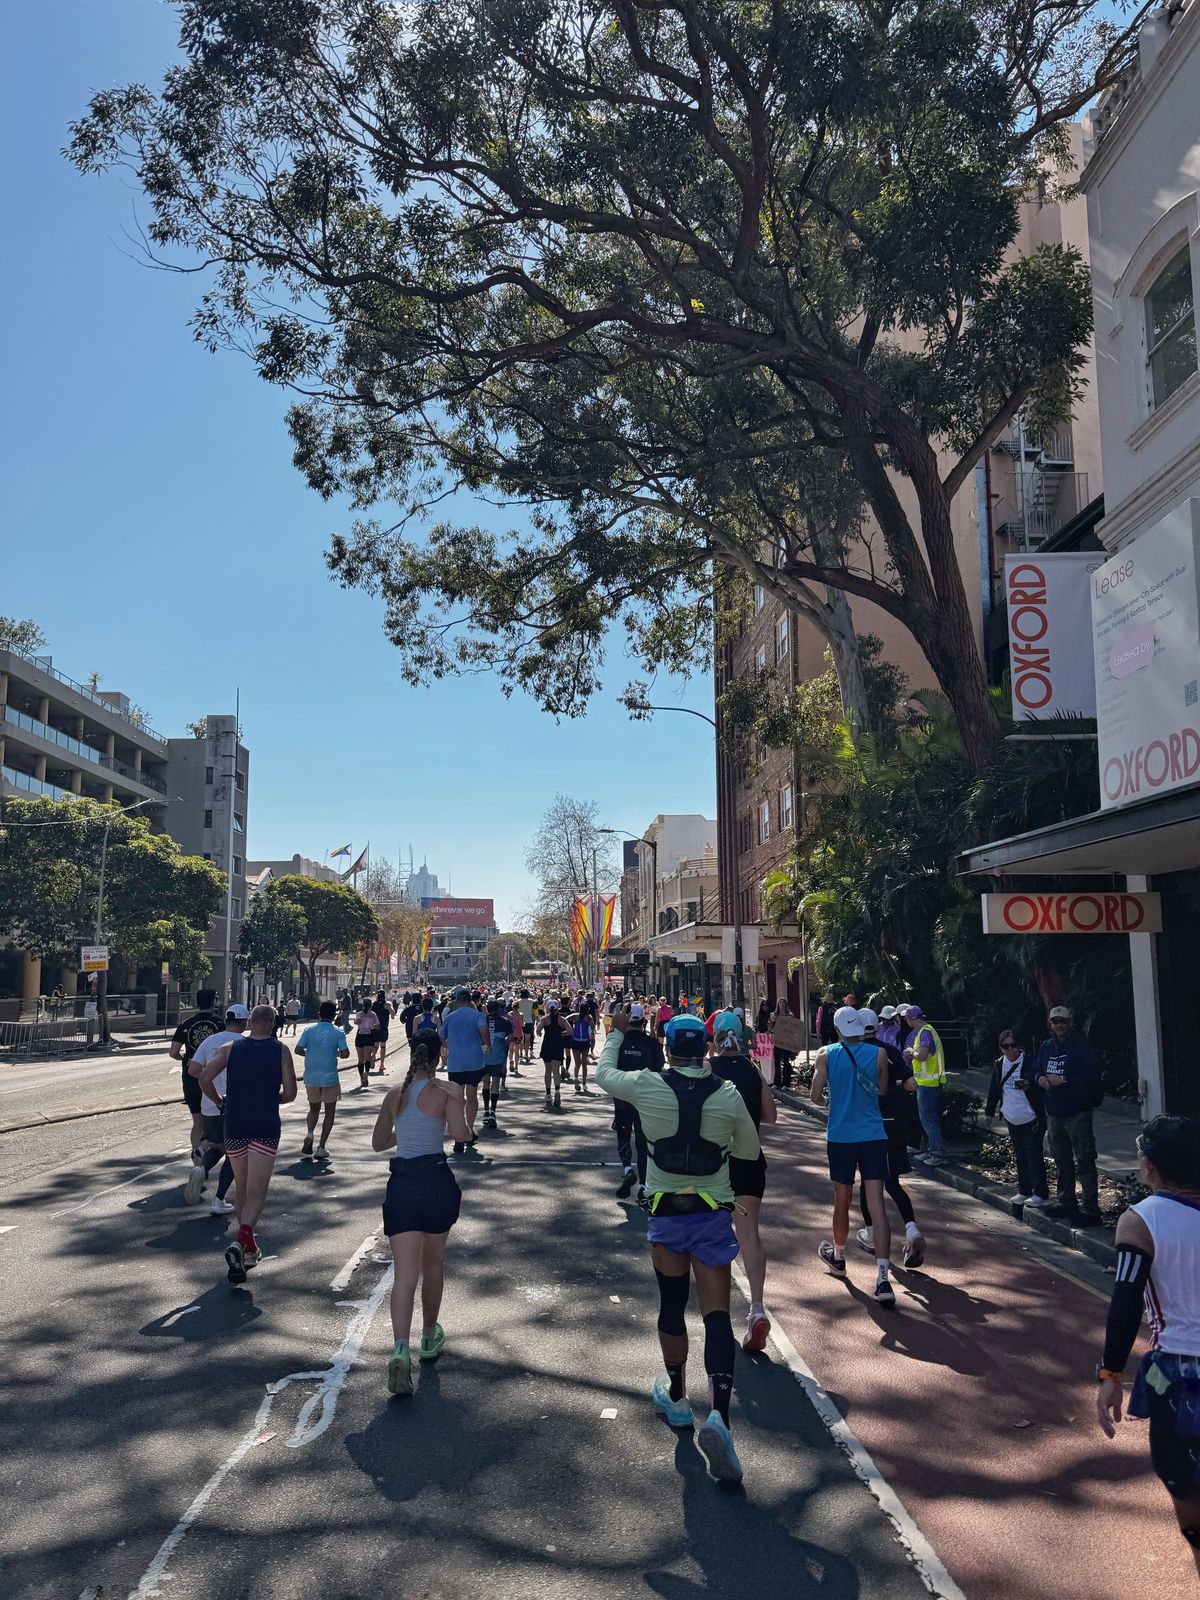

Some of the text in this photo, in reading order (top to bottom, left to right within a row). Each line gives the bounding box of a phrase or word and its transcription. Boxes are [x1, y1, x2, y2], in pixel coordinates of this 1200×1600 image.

[1095, 560, 1135, 600] Lease
[1009, 564, 1053, 709] OXFORD
[1140, 639, 1151, 655] by
[1103, 727, 1200, 801] OXFORD
[1003, 895, 1145, 932] OXFORD
